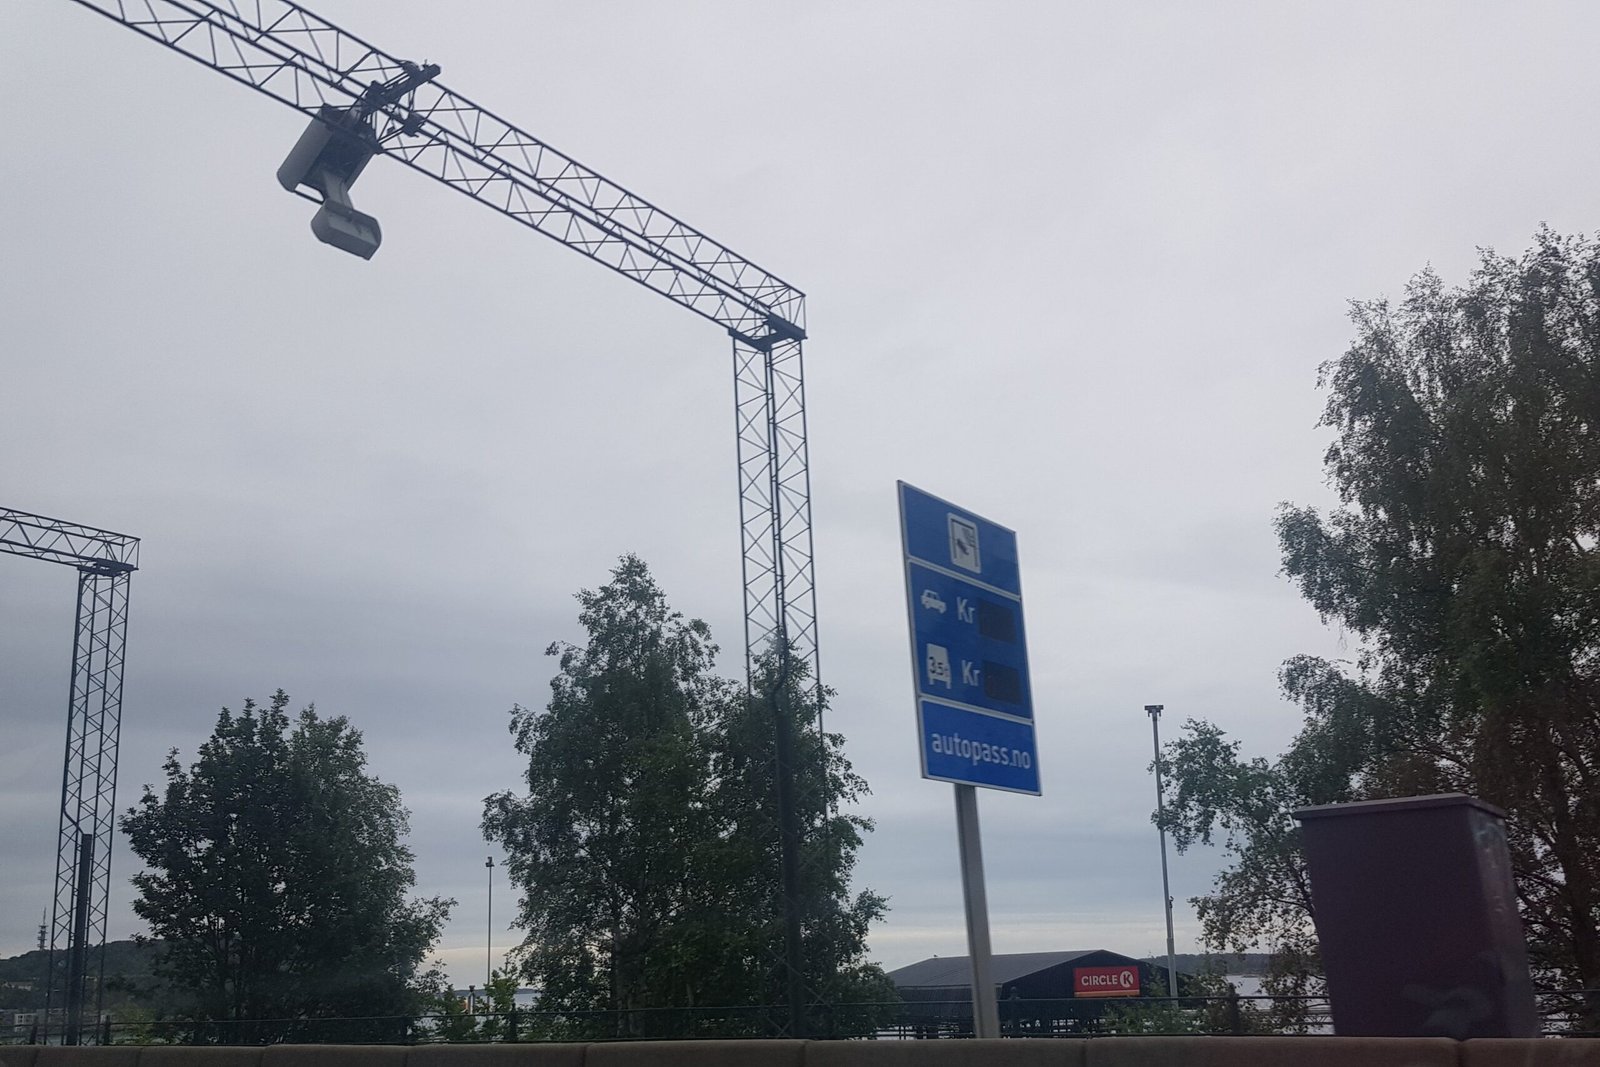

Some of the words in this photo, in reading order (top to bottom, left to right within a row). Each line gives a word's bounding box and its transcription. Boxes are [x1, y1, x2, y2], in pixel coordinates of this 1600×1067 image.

[956, 596, 975, 624] Kr
[961, 660, 980, 686] Kr
[931, 732, 1031, 769] autopass.no
[1081, 975, 1118, 986] CIRCLE
[1120, 971, 1133, 987] K
